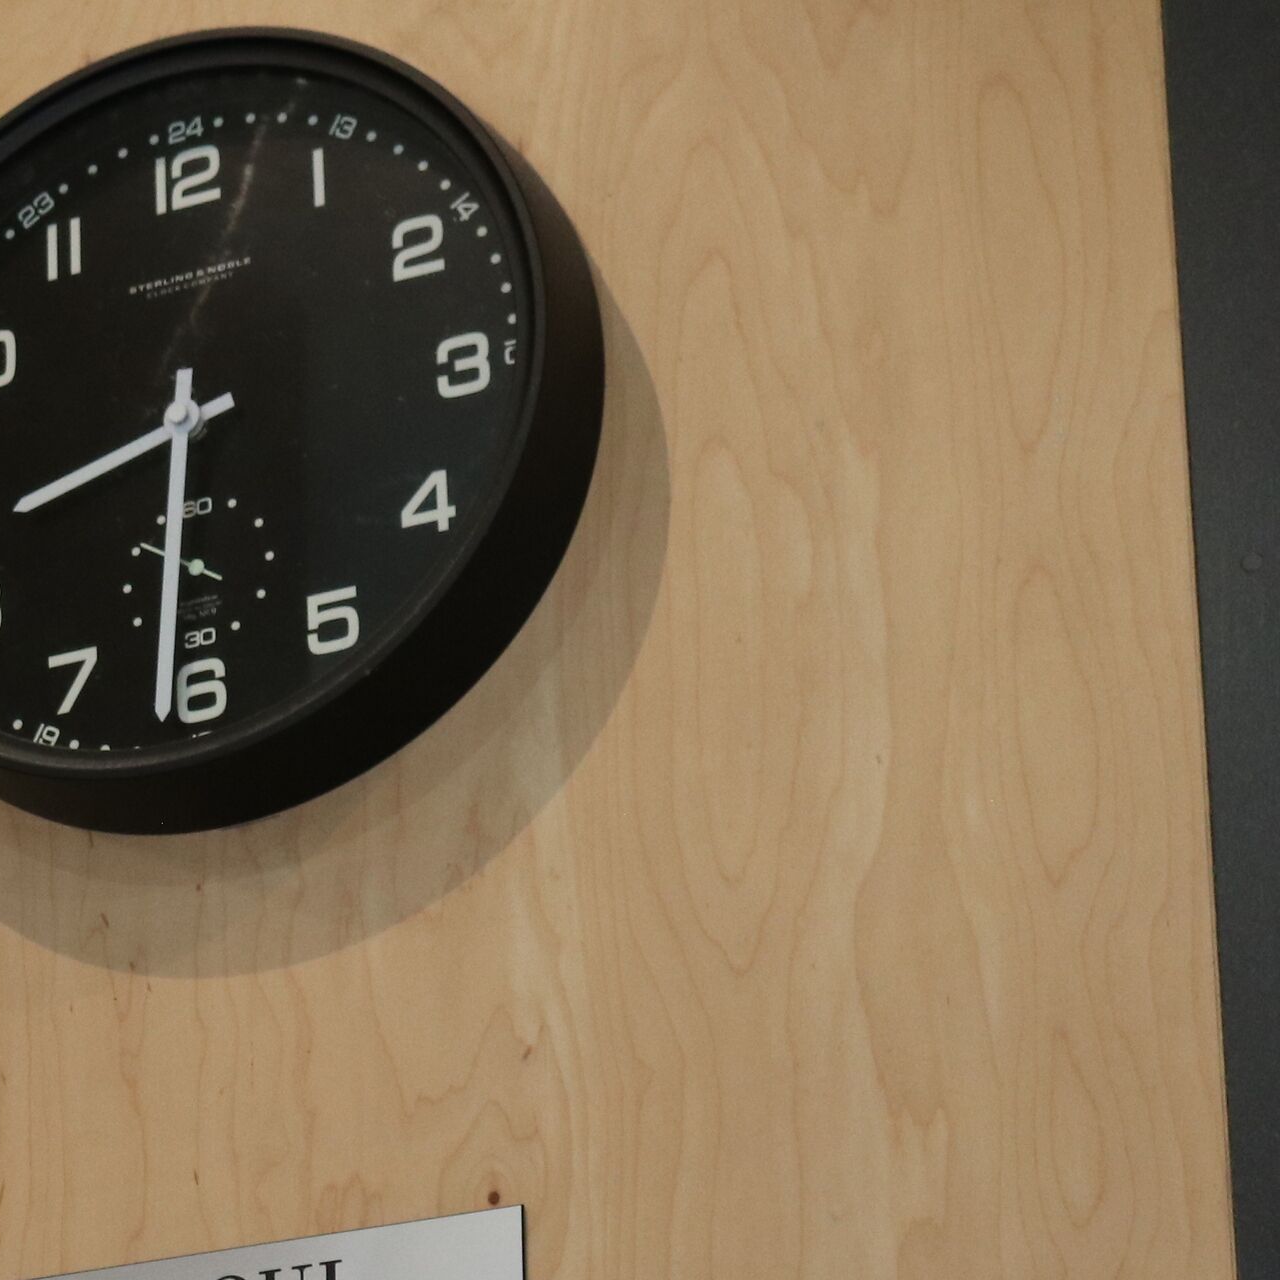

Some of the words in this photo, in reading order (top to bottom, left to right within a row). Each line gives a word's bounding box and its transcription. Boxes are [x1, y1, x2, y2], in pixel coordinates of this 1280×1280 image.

[168, 116, 205, 145] 24
[329, 114, 358, 139] 13
[153, 144, 222, 216] 12
[310, 147, 327, 208] 1
[450, 192, 481, 222] 14
[17, 191, 56, 229] 23
[45, 216, 82, 282] 11
[390, 214, 446, 282] 2
[434, 331, 492, 399] 3
[399, 469, 457, 532] 4
[184, 627, 217, 649] 30
[305, 585, 360, 655] 5
[47, 646, 98, 715] 7
[176, 657, 228, 723] 6
